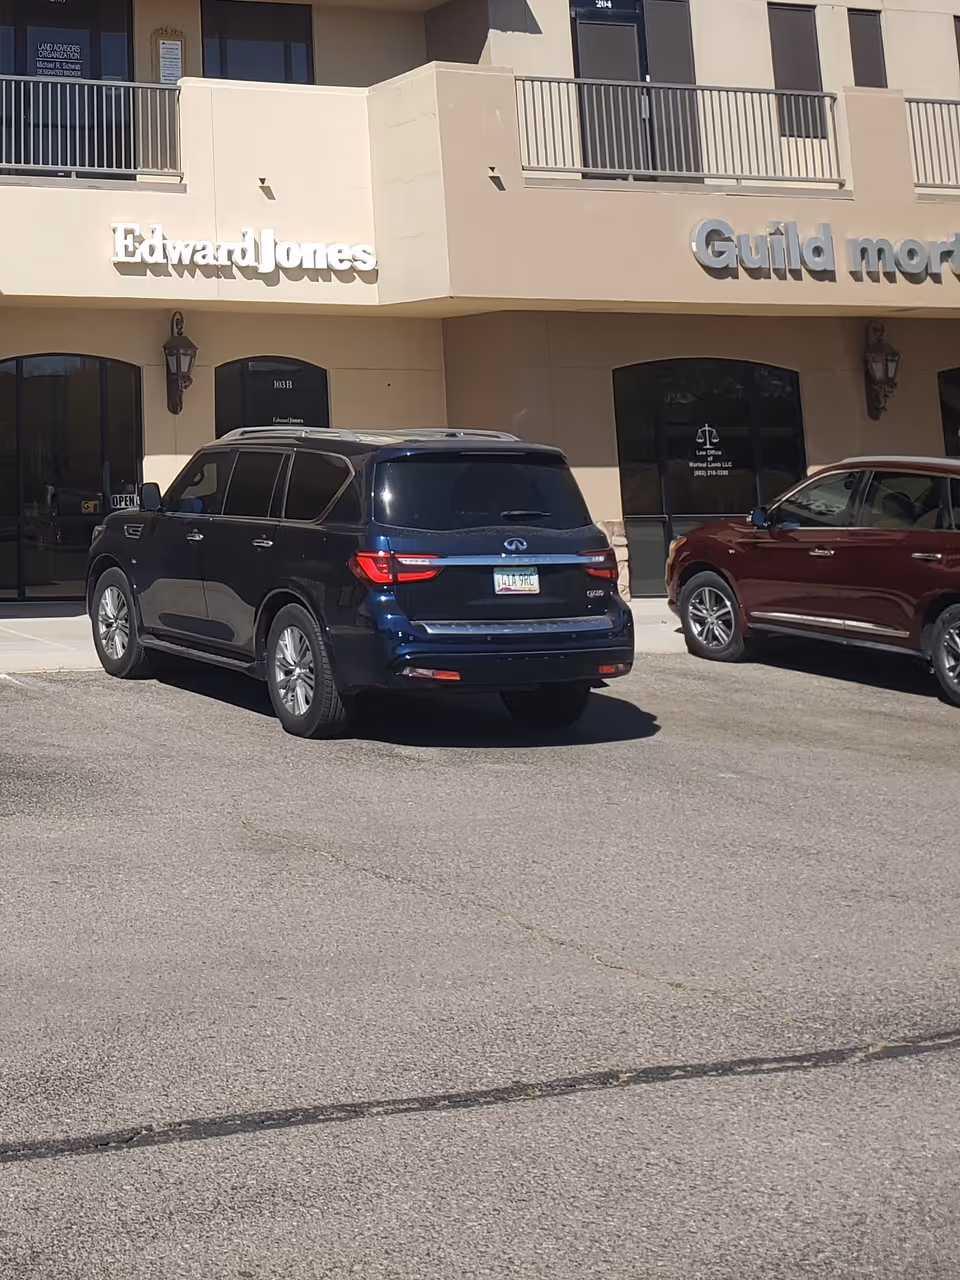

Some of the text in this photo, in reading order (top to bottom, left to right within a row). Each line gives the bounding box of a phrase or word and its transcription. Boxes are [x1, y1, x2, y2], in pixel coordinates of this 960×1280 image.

[595, 0, 612, 9] 204
[37, 42, 81, 53] LAND ADVISORS
[38, 50, 80, 60] ORGANIZATION
[691, 218, 835, 271] Guild
[112, 495, 135, 507] OPEN
